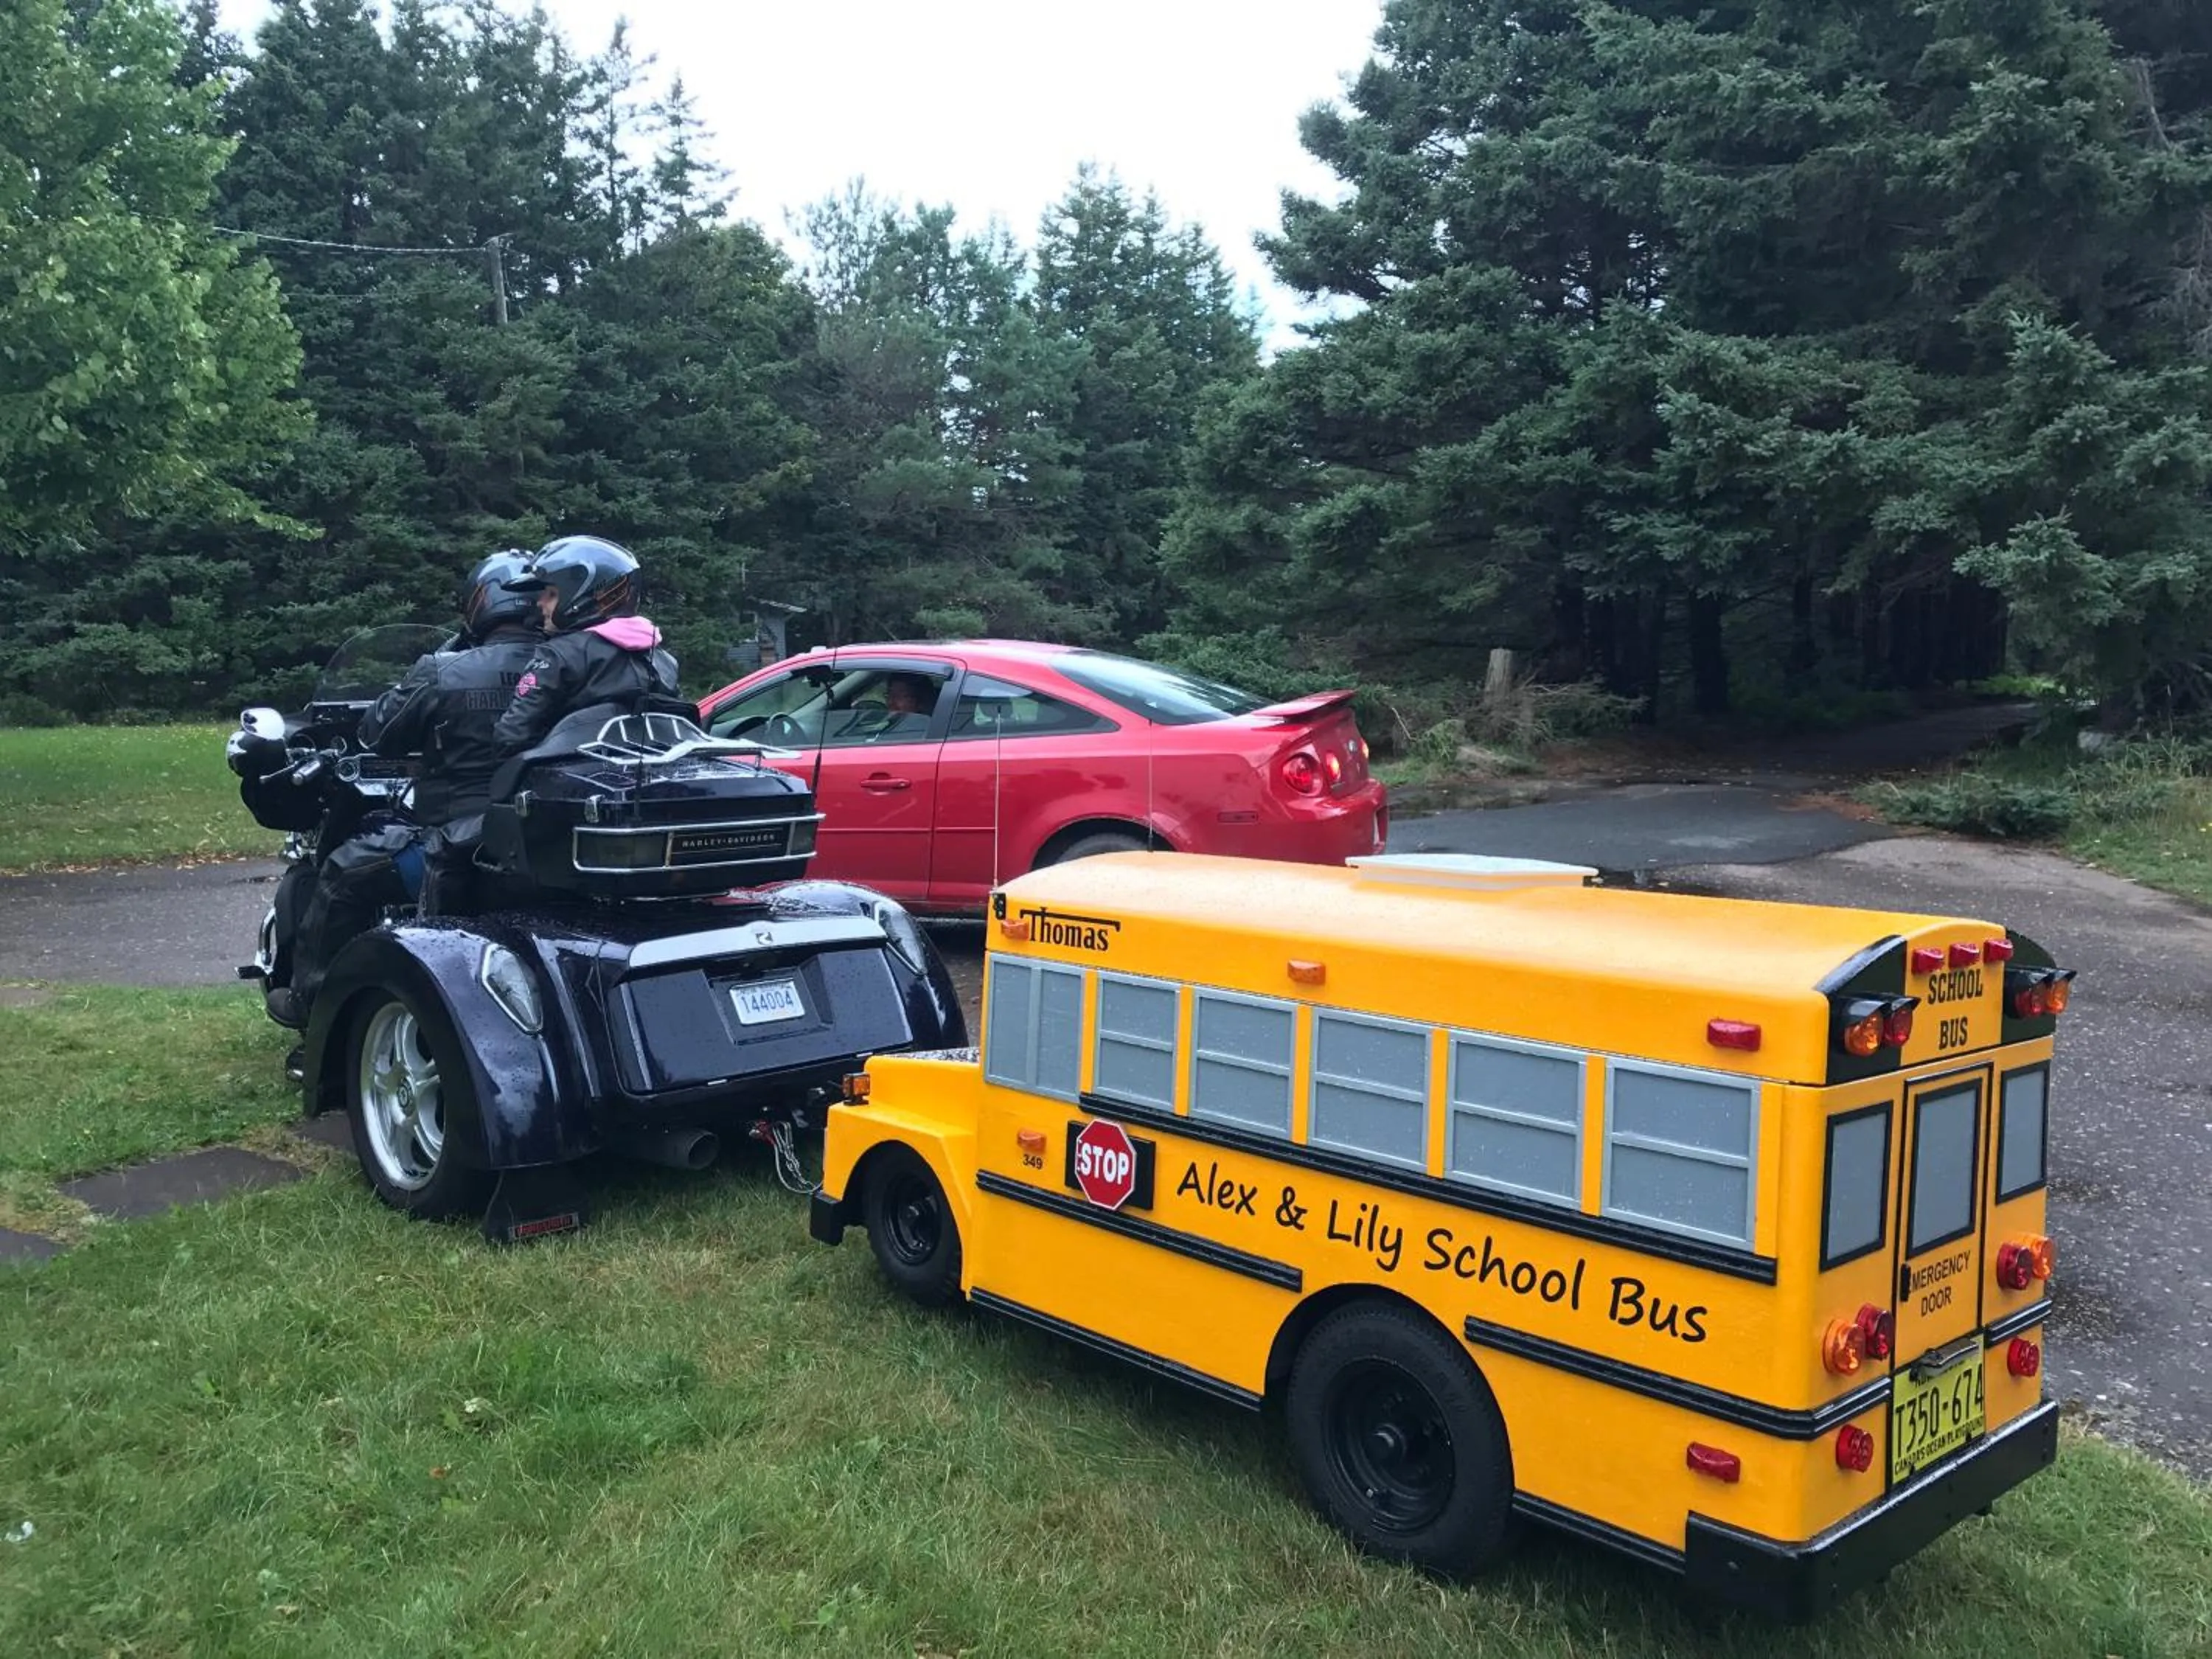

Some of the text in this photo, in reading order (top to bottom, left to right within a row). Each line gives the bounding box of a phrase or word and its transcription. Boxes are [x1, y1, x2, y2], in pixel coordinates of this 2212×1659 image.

[682, 834, 775, 848] HARLEY-DAVIDSON
[1020, 907, 1121, 951] Thomas
[740, 990, 794, 1014] 144004
[1927, 968, 1983, 1005] SCHOOL
[1938, 1015, 1968, 1050] BUS
[1023, 1154, 1043, 1169] 349
[1080, 1142, 1130, 1185] STOP
[1176, 1161, 1708, 1343] Alex & Lily School Bus
[1908, 1250, 1971, 1293] MERGENCY
[1921, 1286, 1952, 1317] DOOR
[1895, 1363, 1983, 1458] T350-674
